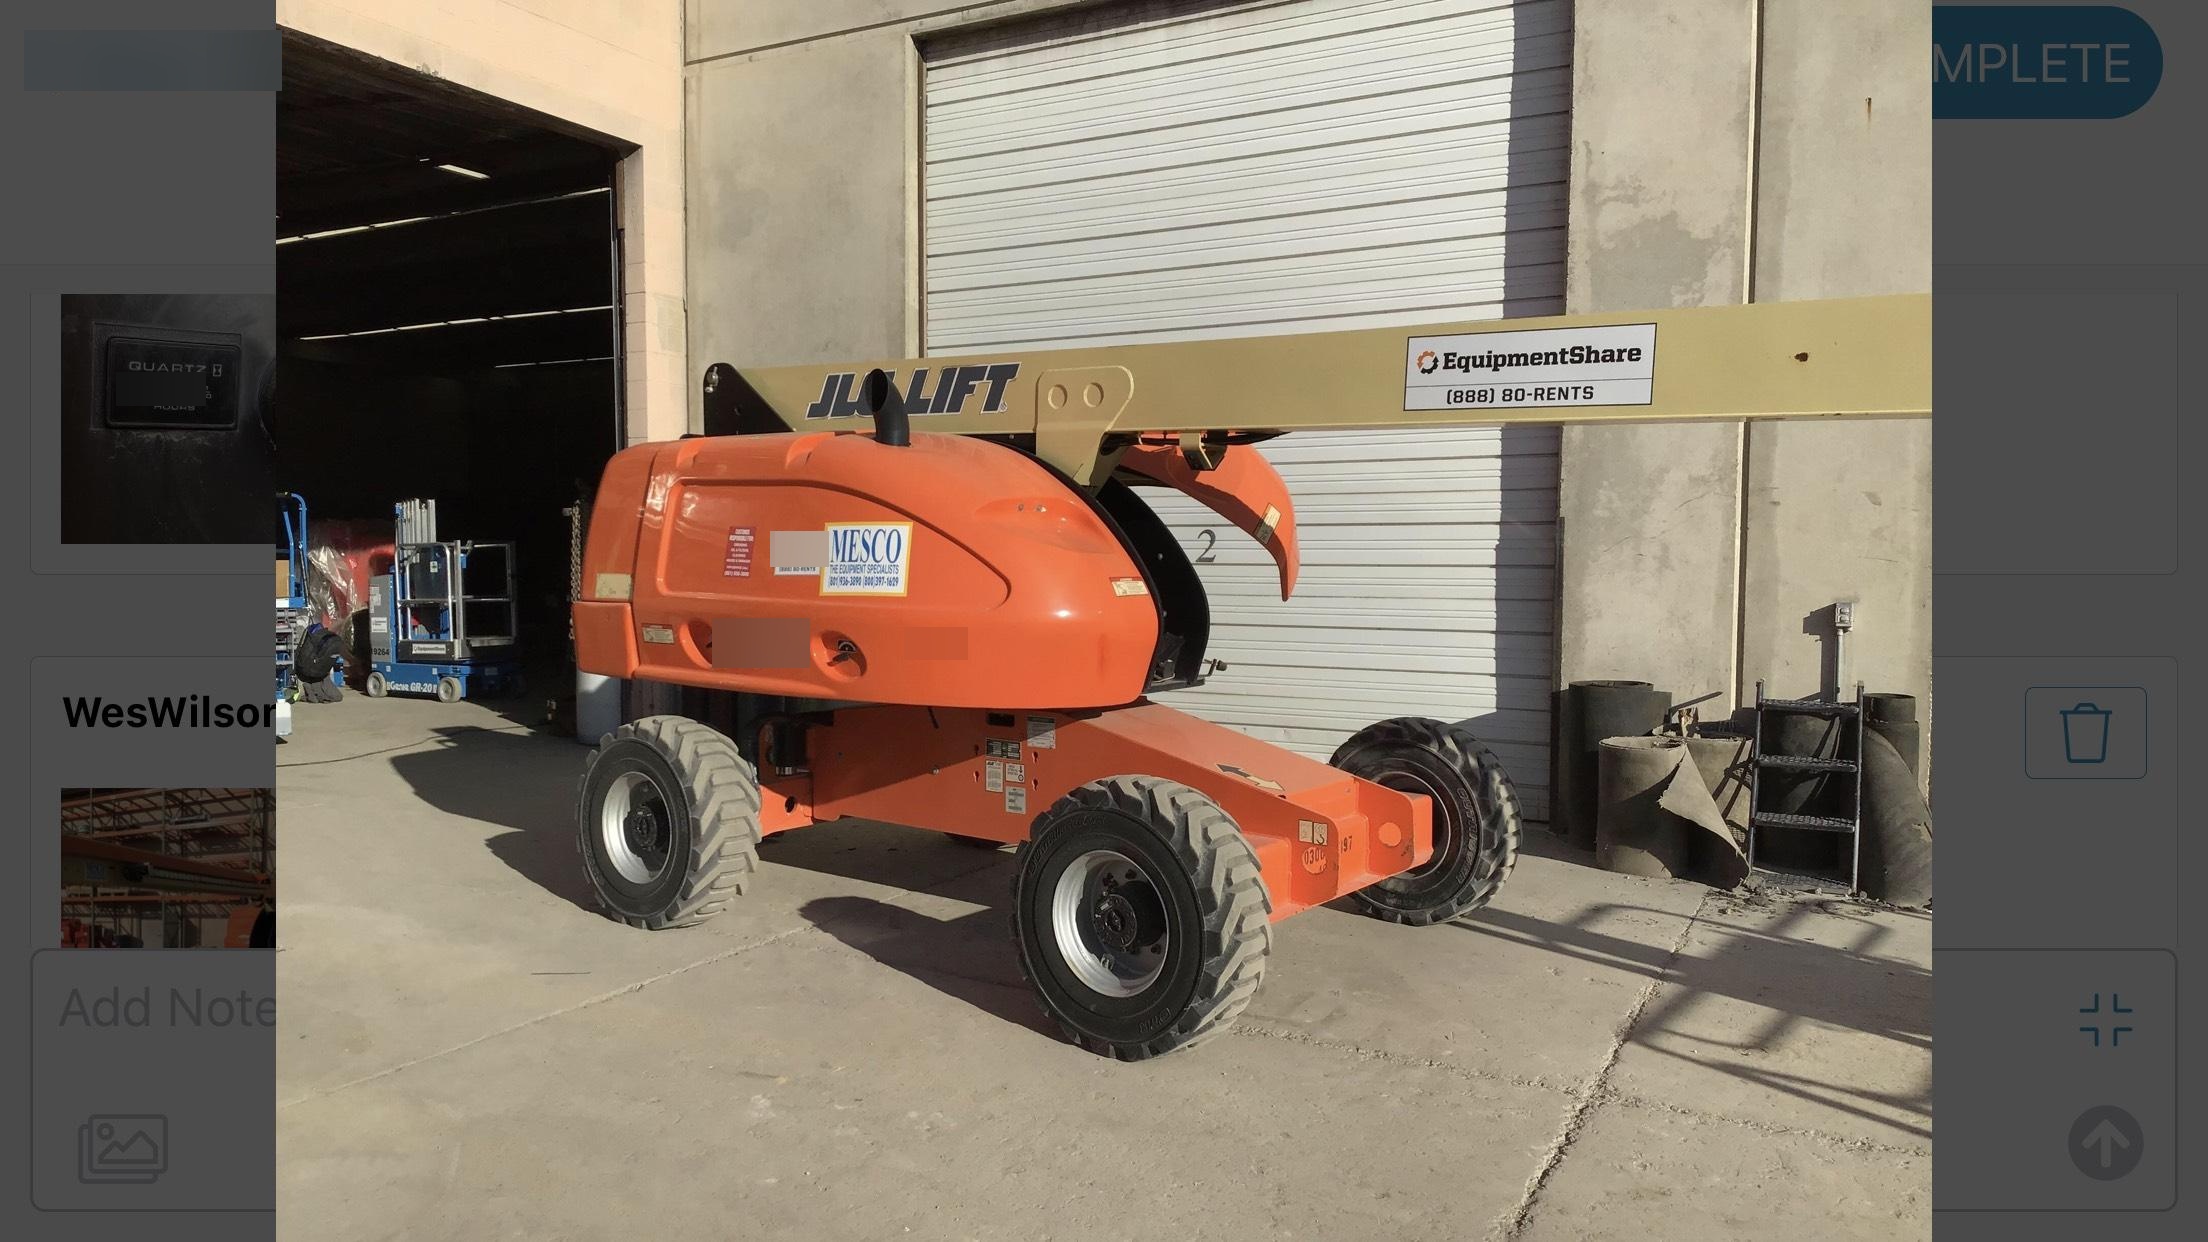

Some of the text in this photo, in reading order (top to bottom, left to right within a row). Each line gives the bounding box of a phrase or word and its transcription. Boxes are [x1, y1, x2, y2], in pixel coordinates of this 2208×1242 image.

[128, 361, 207, 372] QUARTZ
[1442, 345, 1642, 373] EquipmentShare
[904, 362, 1022, 415] LIFT
[1446, 385, 1595, 405] (888) 80-RENTS
[830, 528, 901, 563] MESCO
[1195, 529, 1216, 562] 2
[829, 564, 899, 574] THE EQUIPMENT SPECIALISTS
